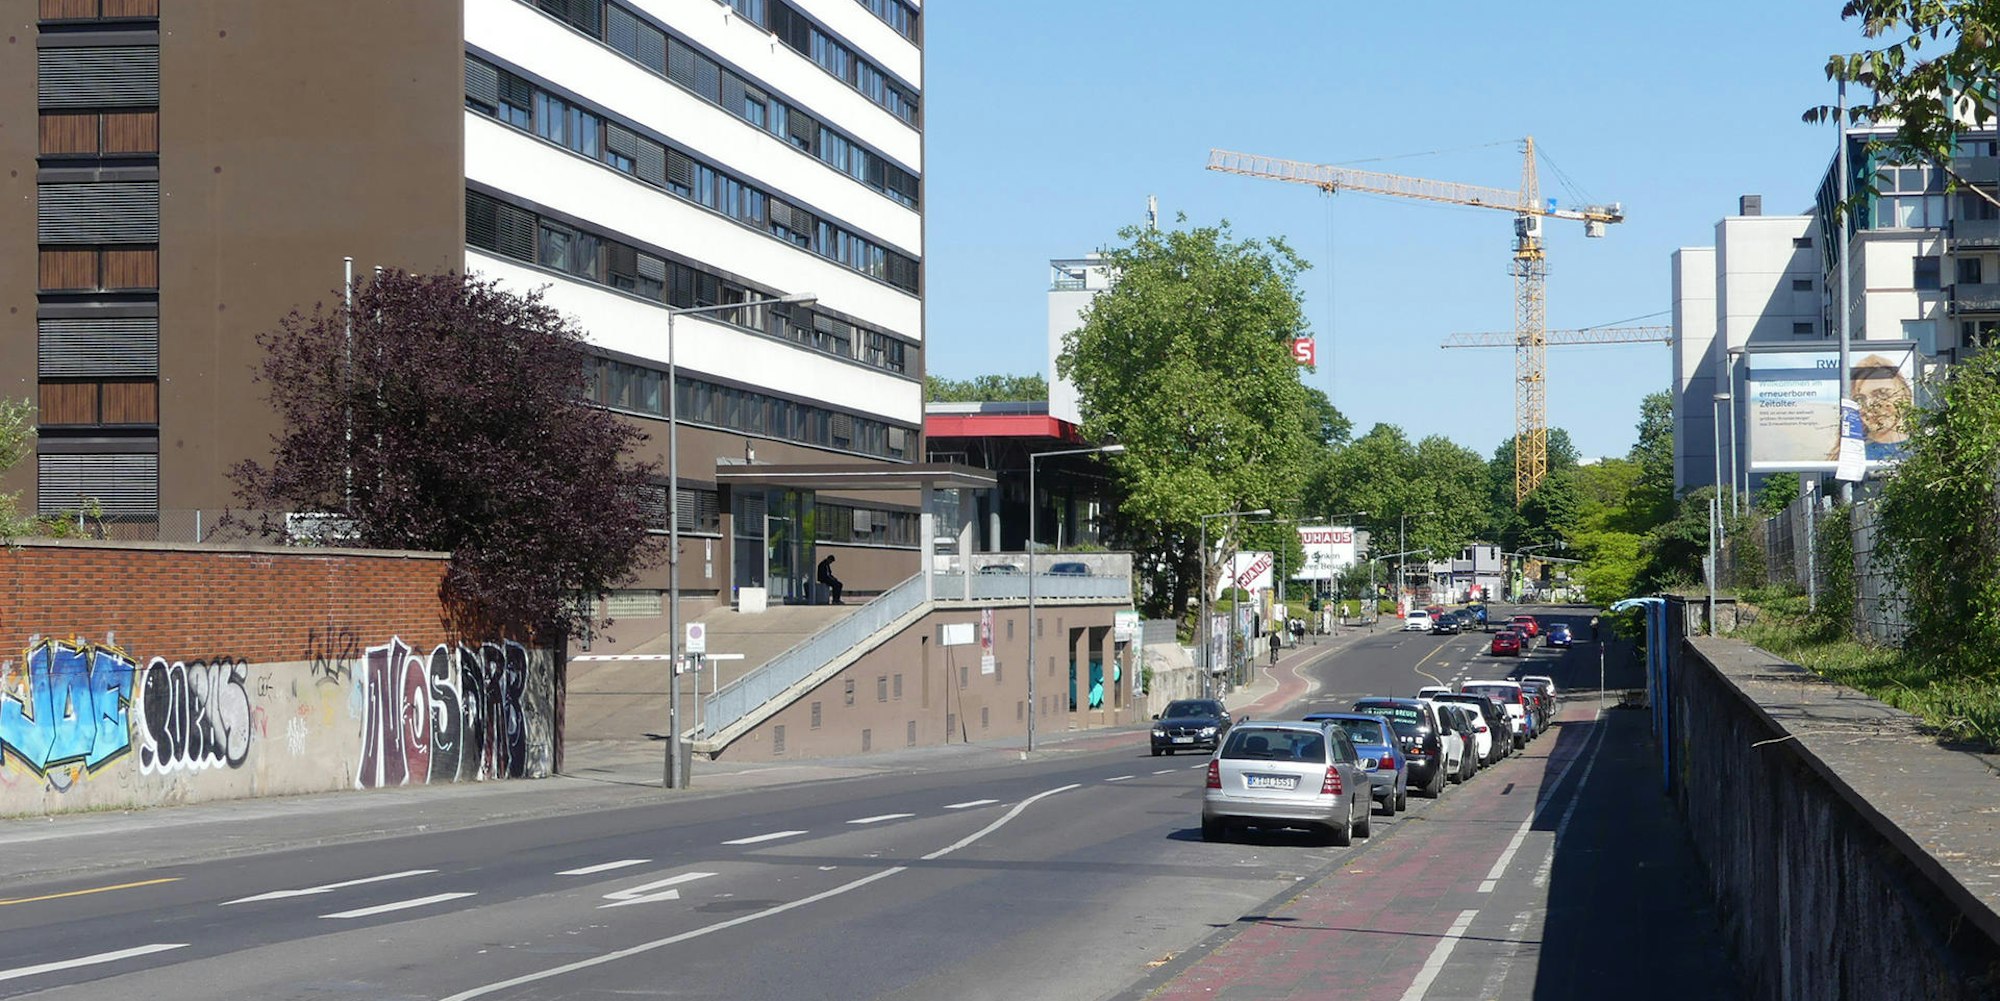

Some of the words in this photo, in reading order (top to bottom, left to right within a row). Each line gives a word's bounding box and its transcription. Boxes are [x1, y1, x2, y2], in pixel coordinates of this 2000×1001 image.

[1816, 359, 1840, 369] RW
[1759, 390, 1817, 398] erneuerbaren
[1759, 400, 1797, 408] Zeitalter.
[1297, 532, 1352, 544] UHAUS
